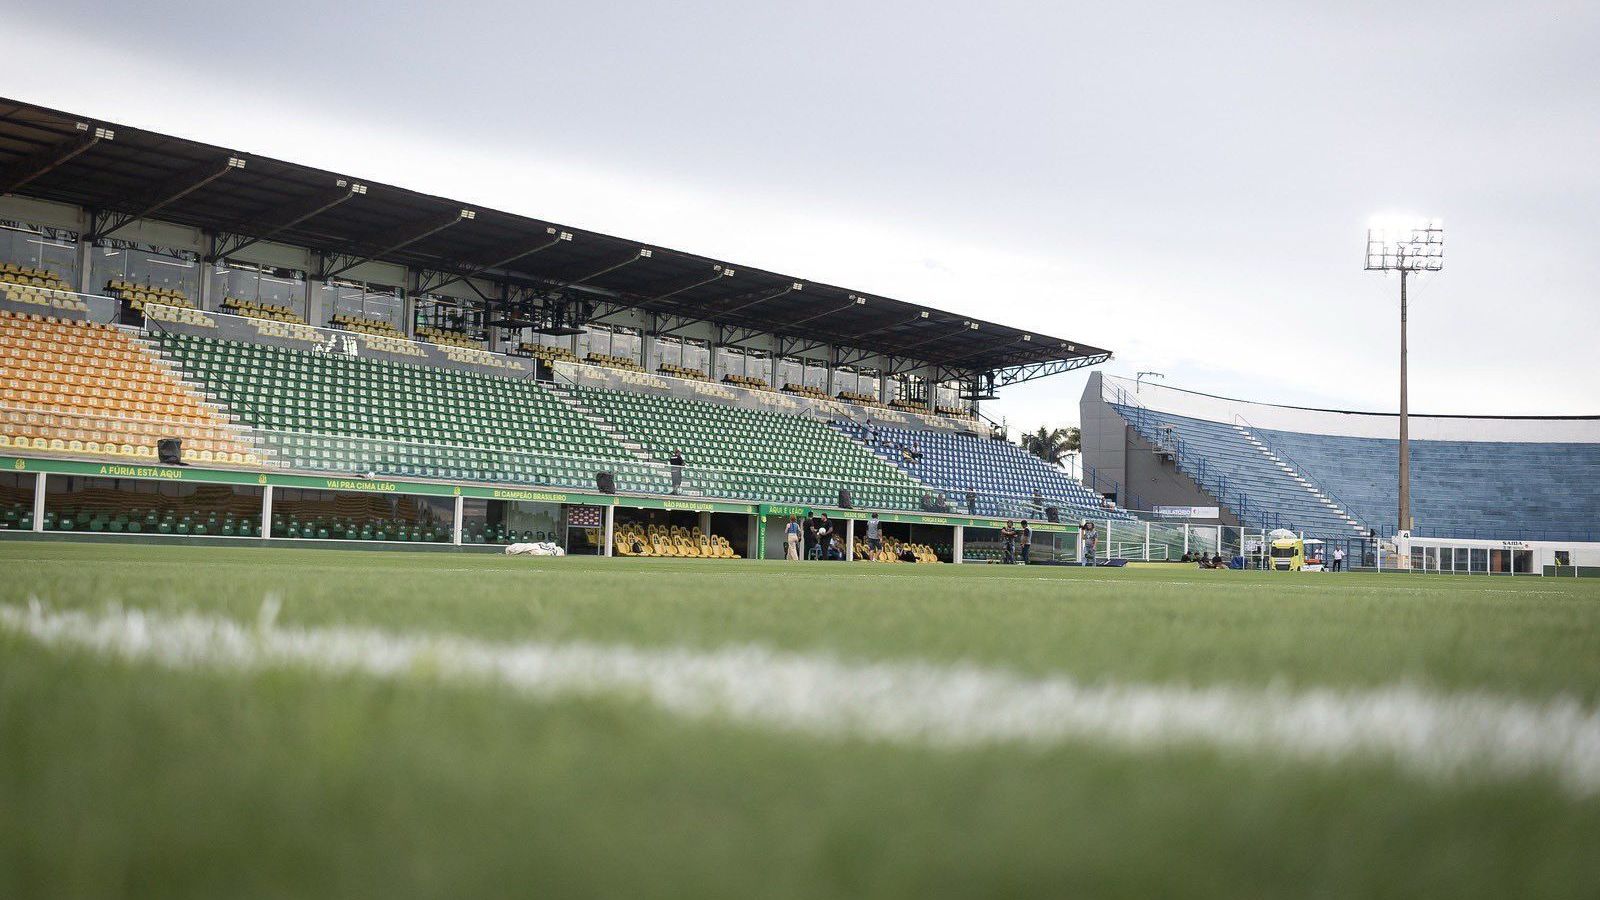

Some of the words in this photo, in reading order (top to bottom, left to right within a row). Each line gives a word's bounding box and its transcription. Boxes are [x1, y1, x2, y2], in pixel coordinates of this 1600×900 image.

[100, 465, 107, 474] A
[109, 465, 135, 475] FÚRIA
[137, 467, 158, 477] ESTÁ
[160, 469, 182, 479] AQUI
[327, 480, 339, 488] VAI
[340, 481, 355, 489] PRA
[356, 482, 376, 490] CIMA
[377, 482, 396, 491] LEÃO
